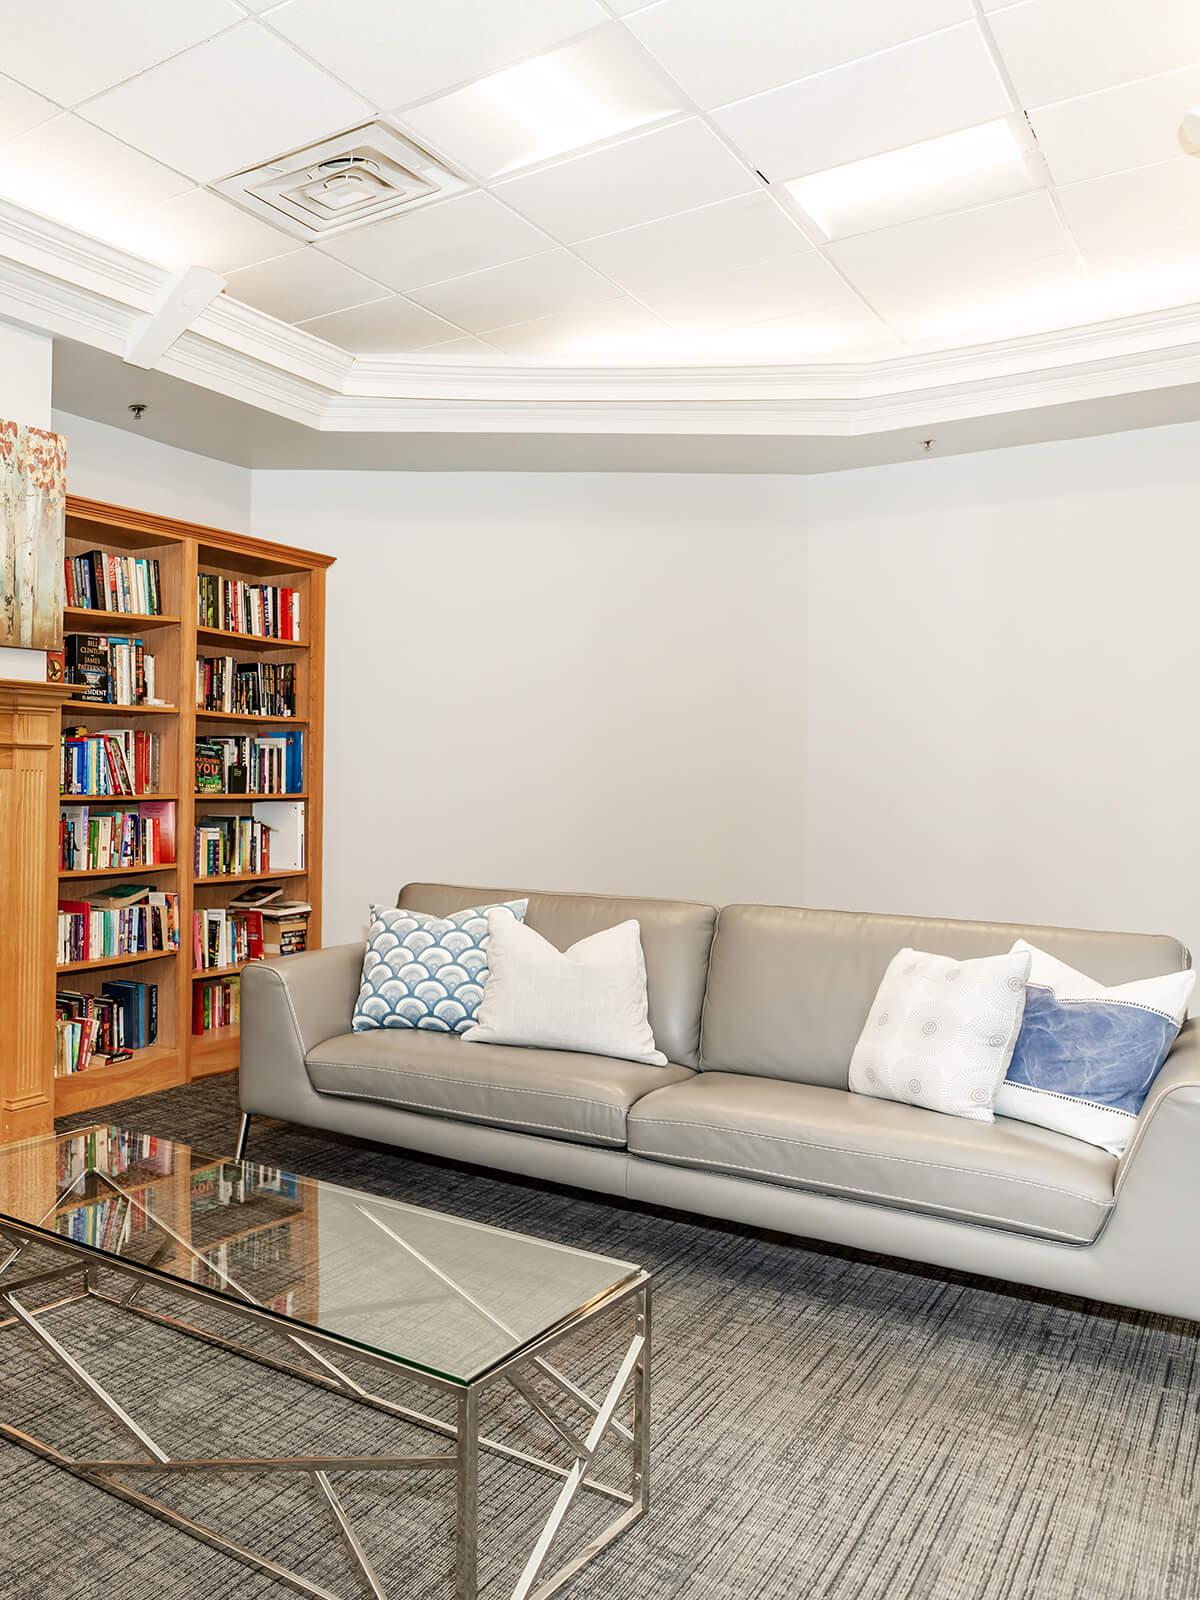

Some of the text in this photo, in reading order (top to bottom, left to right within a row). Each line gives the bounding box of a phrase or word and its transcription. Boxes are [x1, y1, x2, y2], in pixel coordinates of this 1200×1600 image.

[80, 646, 104, 655] CLINTON
[78, 664, 106, 672] PATTERSON
[197, 763, 218, 774] YOU
